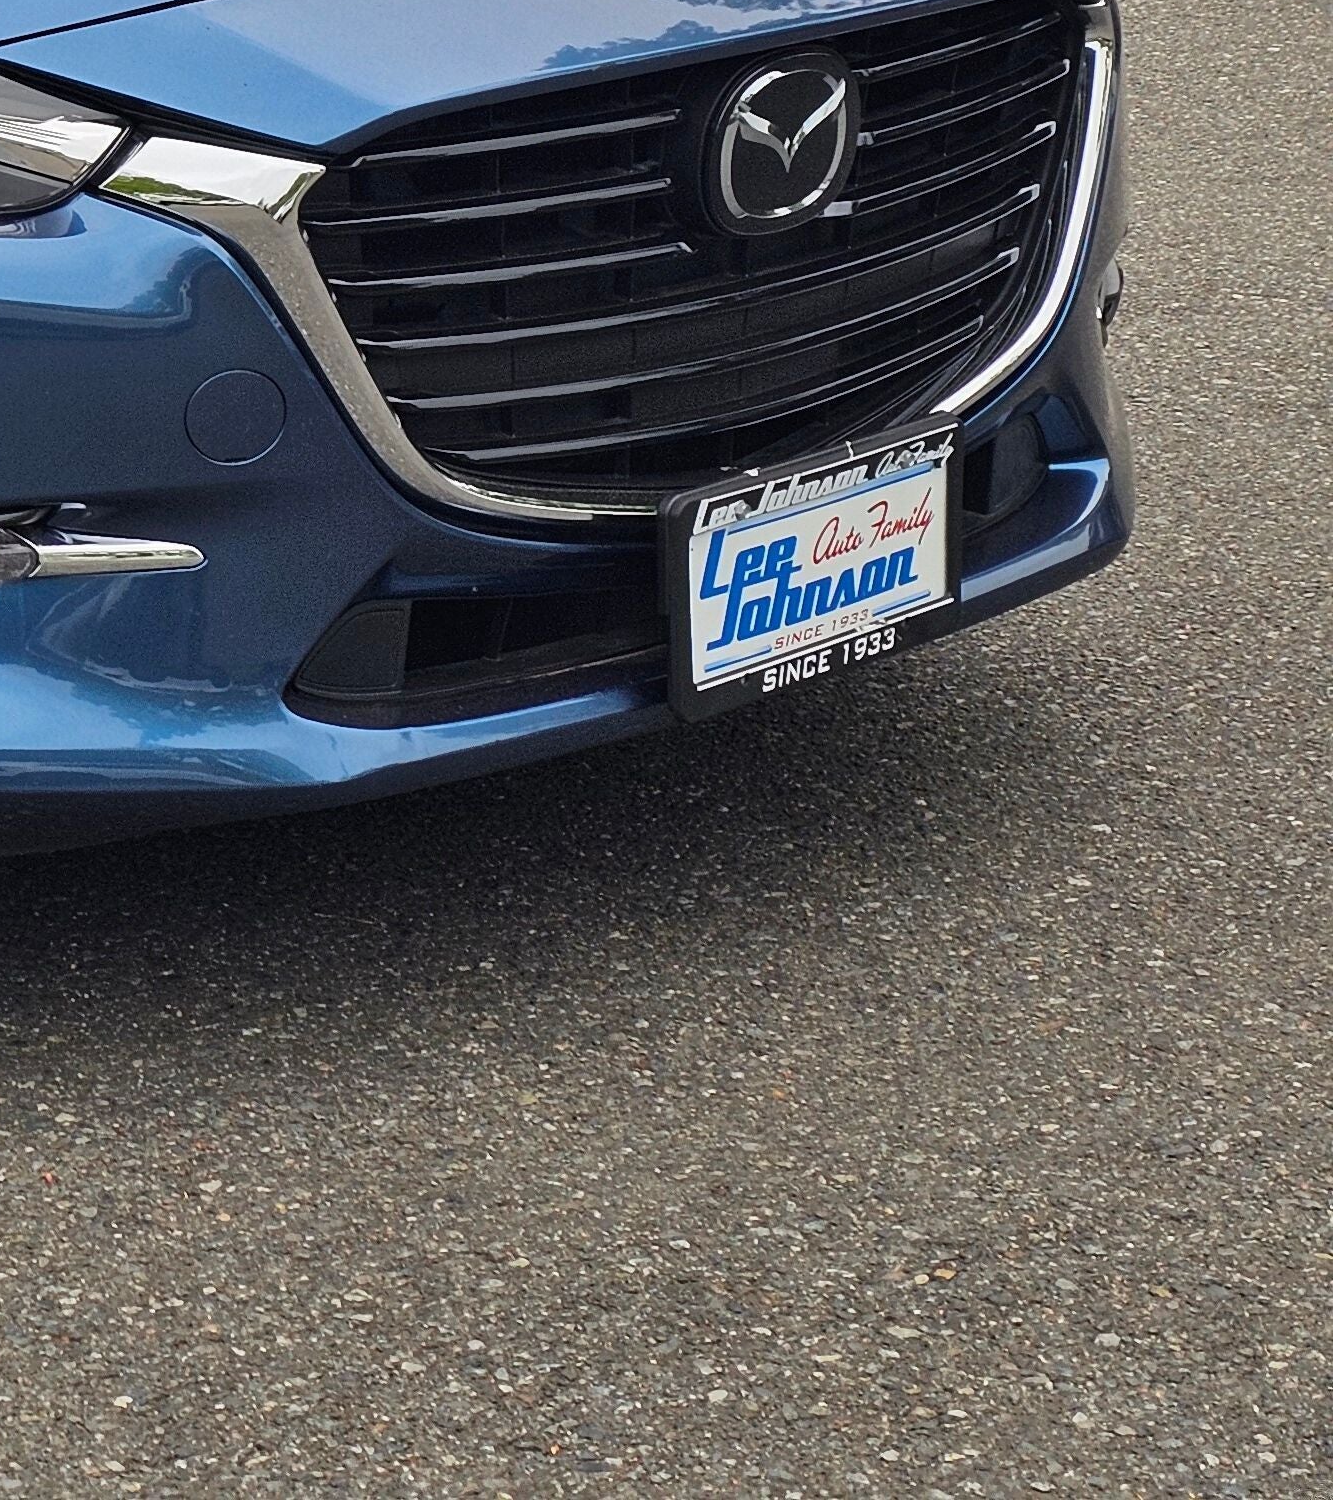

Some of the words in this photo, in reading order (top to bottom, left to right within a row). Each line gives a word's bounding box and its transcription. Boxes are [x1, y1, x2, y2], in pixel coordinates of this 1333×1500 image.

[693, 498, 746, 536] Lee
[745, 463, 870, 519] Johnson
[813, 516, 863, 565] Auto
[867, 487, 935, 548] Family
[700, 529, 803, 600] Lee
[706, 546, 919, 652] Johnson
[762, 647, 832, 694] SINCE
[842, 626, 897, 666] 1933
[774, 623, 824, 651] SINCE
[831, 608, 870, 632] 1933
